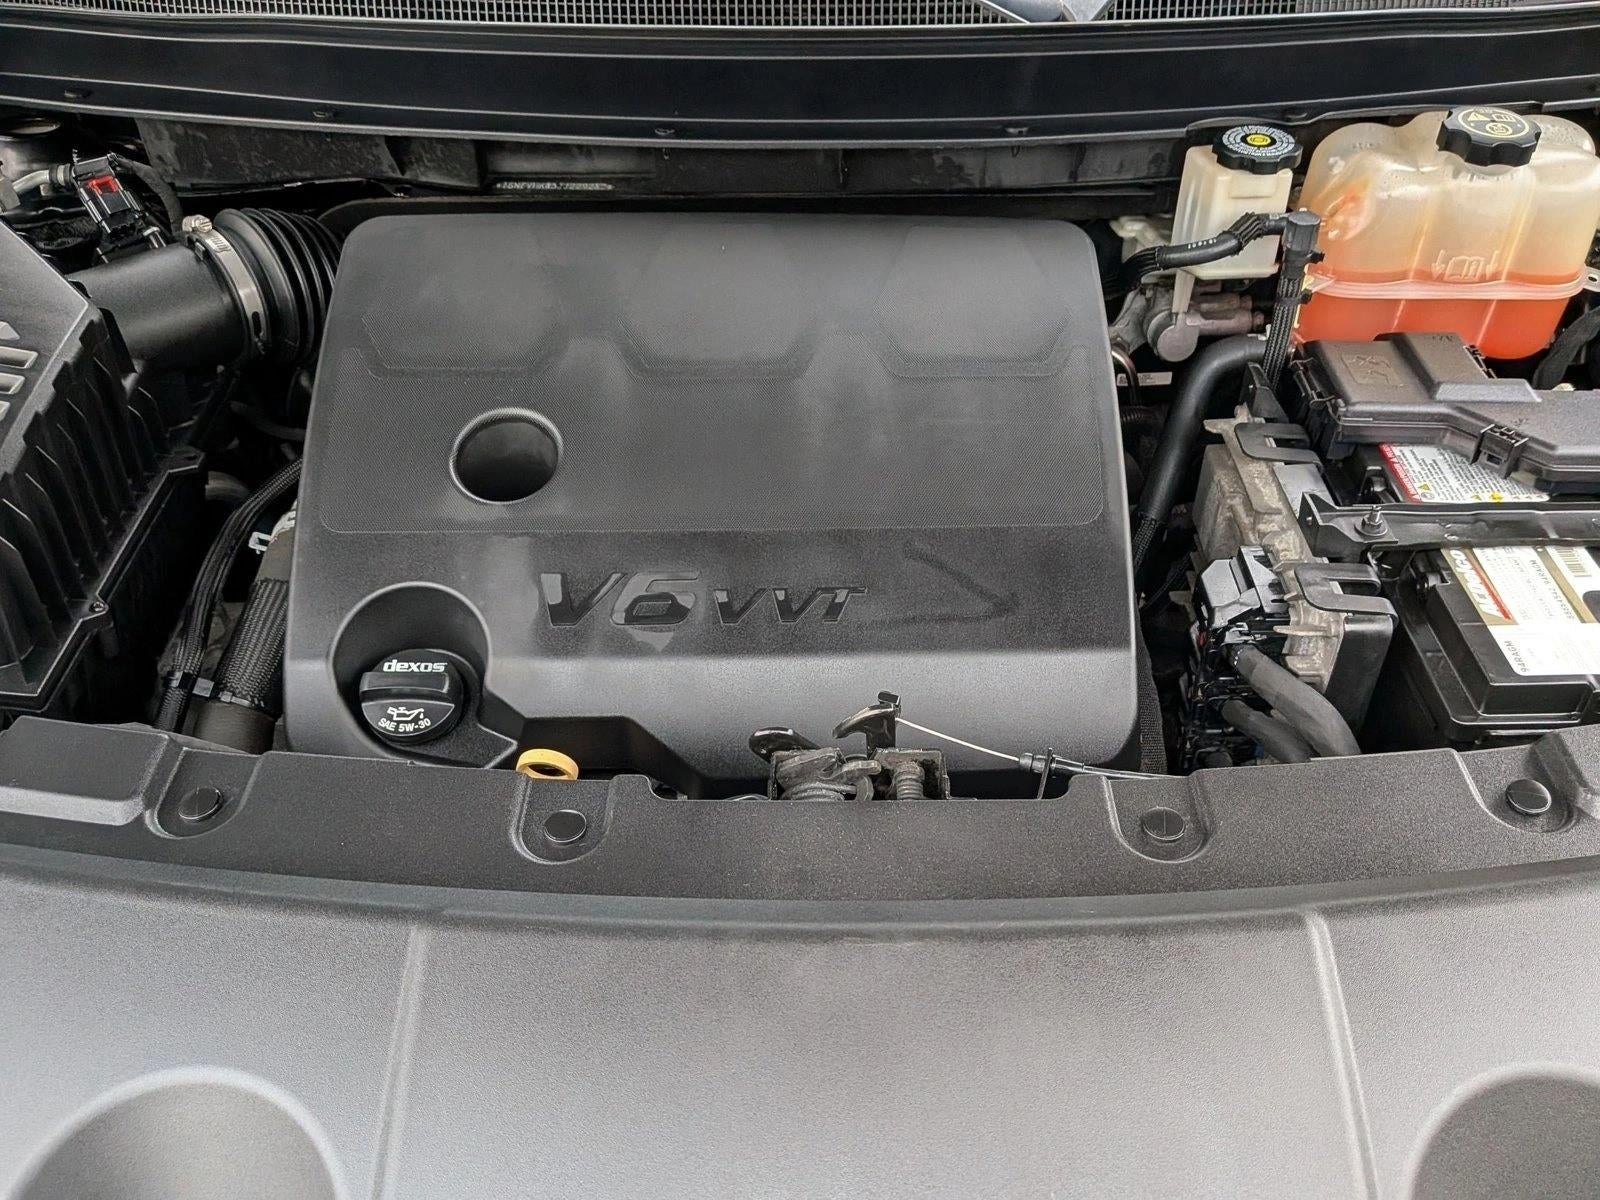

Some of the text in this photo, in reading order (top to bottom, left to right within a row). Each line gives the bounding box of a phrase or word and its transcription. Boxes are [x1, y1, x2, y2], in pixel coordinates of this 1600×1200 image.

[540, 572, 868, 627] V6 VVT
[383, 659, 448, 673] dexos
[1504, 640, 1529, 673] 94RAGM
[378, 717, 431, 732] SAE 5W-30
